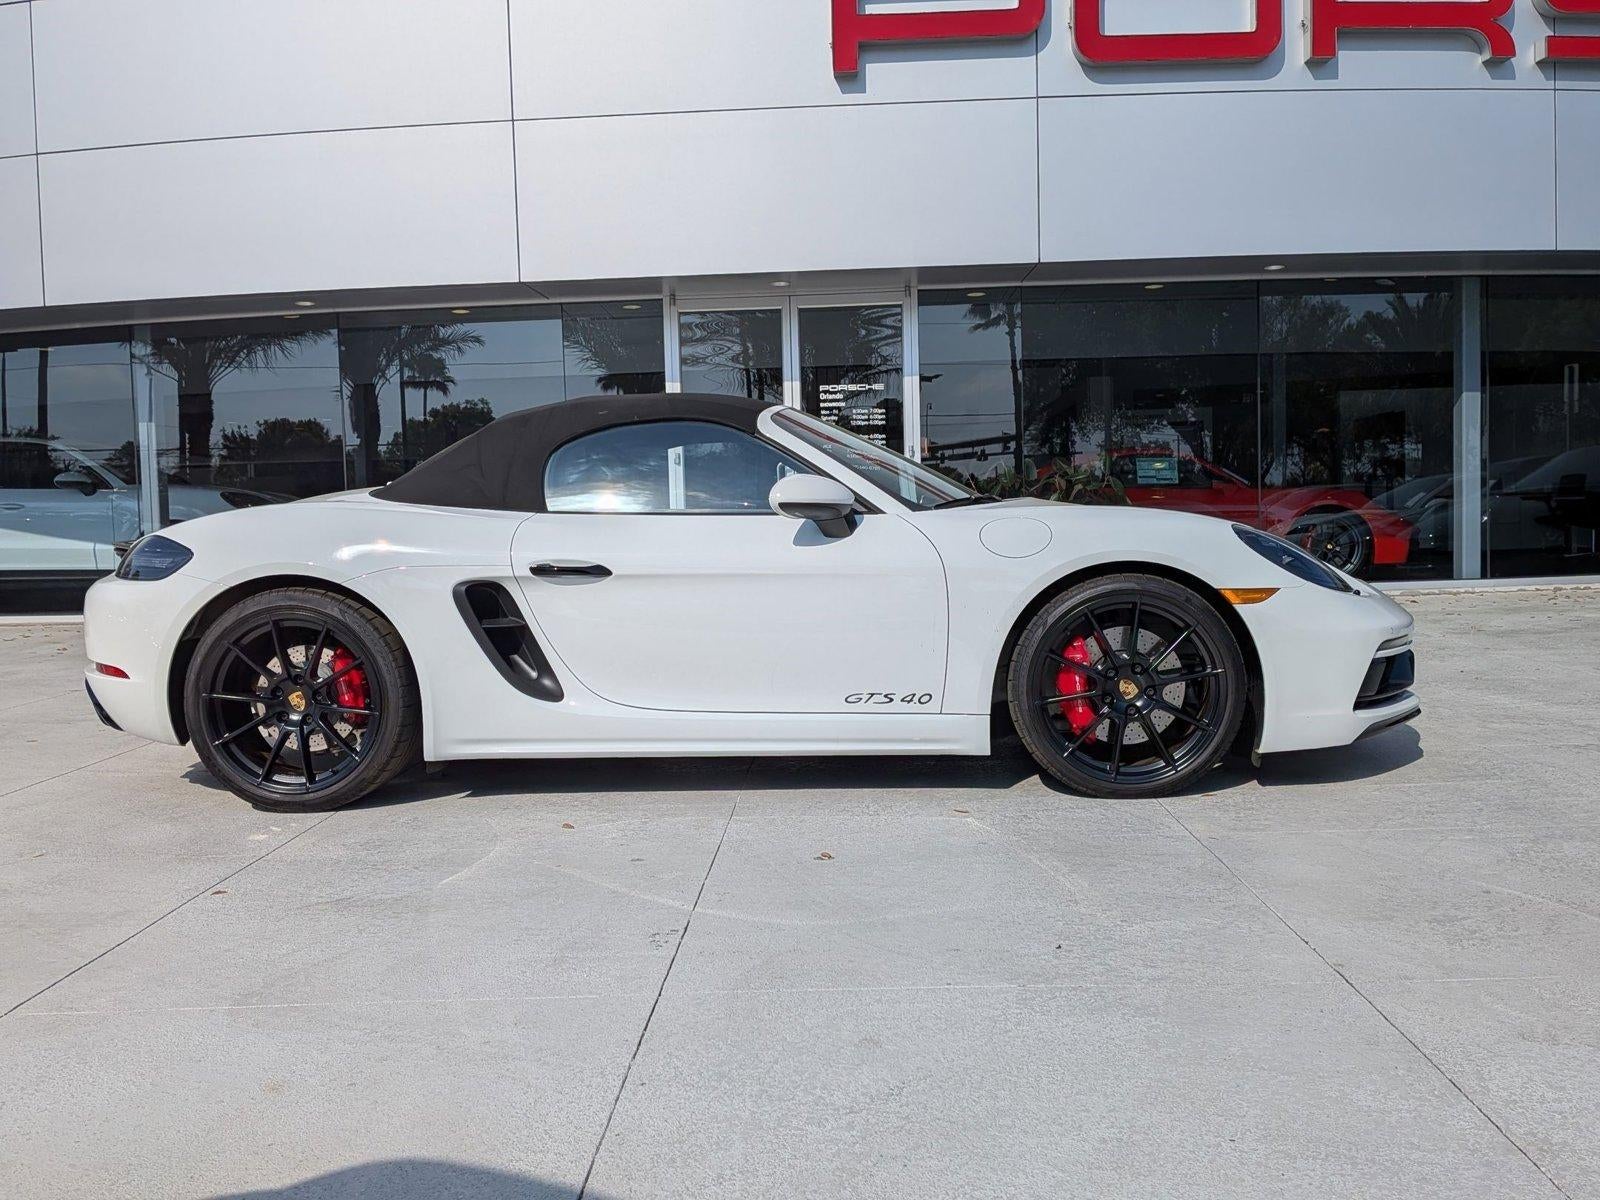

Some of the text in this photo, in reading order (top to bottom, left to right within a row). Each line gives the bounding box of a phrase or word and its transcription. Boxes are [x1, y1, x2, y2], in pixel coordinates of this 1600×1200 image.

[819, 383, 885, 392] PORSCHE
[819, 392, 843, 400] Orlando
[844, 692, 932, 705] GTS 4.0
